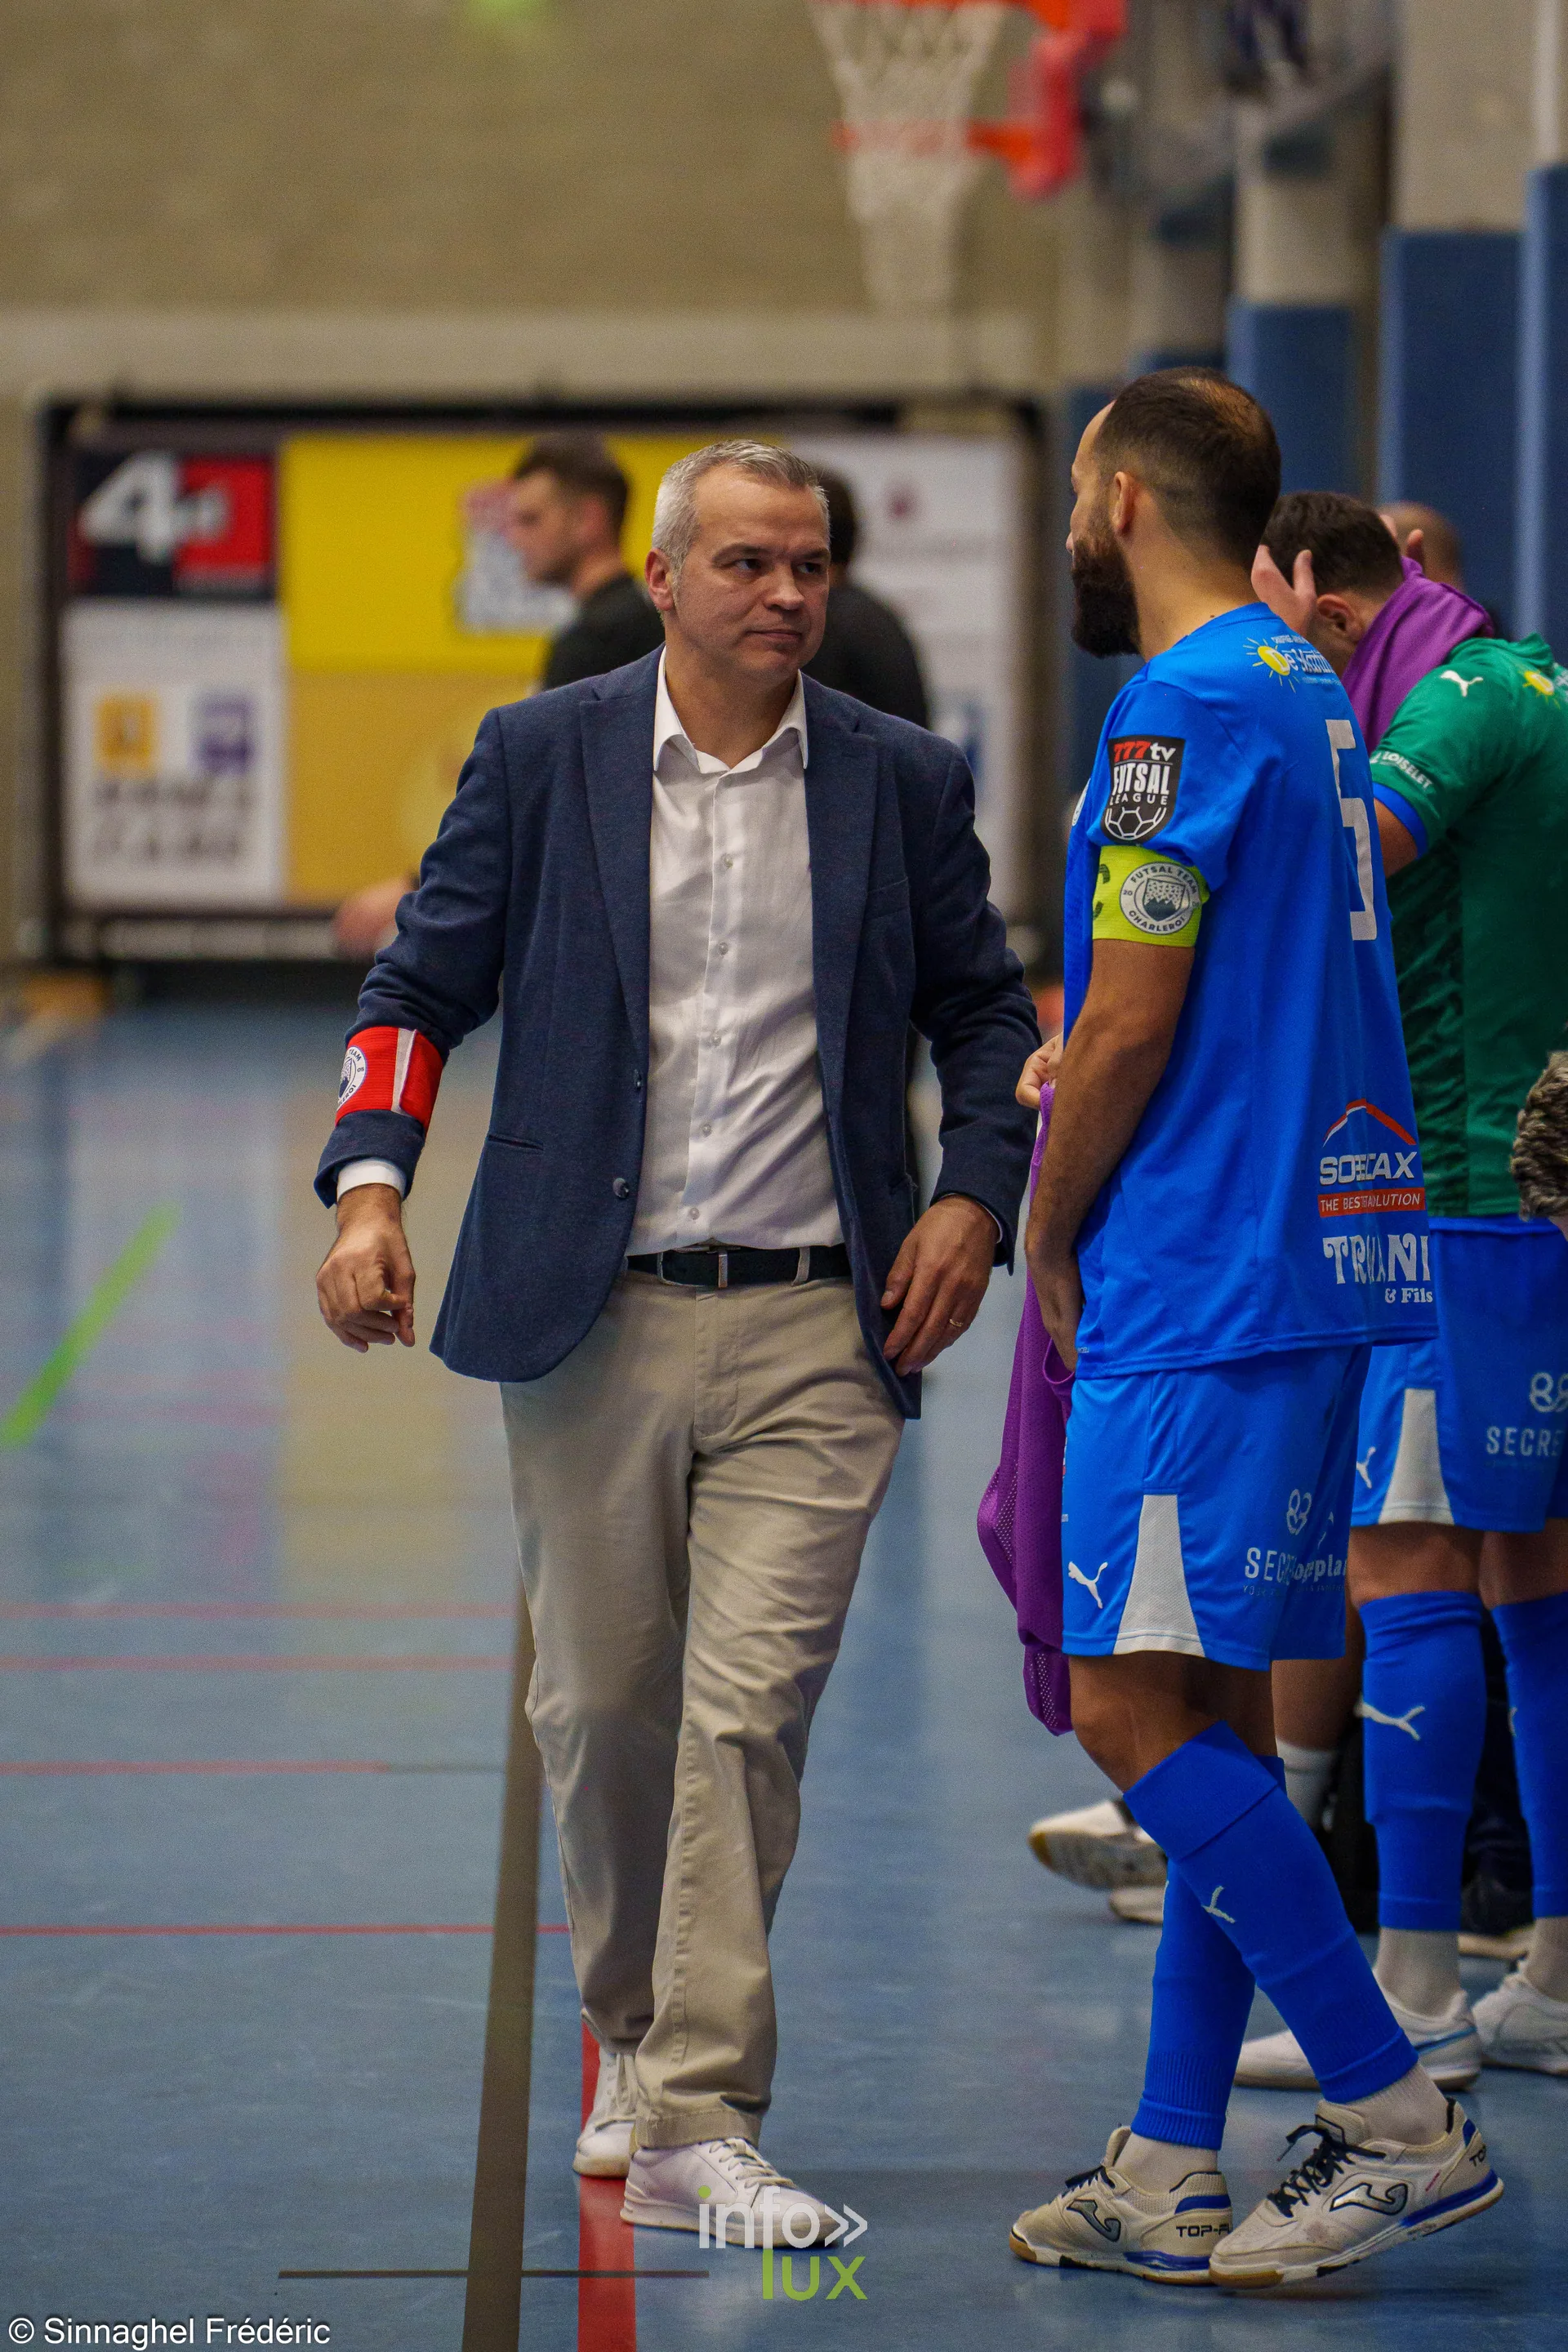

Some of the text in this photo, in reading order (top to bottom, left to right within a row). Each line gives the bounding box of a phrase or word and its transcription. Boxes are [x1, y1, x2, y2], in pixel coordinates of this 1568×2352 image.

[1112, 763, 1170, 795] FUTSAL
[1382, 751, 1432, 790] LOISELET
[1110, 793, 1168, 805] LEAGUE
[1325, 719, 1378, 941] 5
[1130, 866, 1198, 894] FUTSAL TEAM
[1129, 910, 1186, 932] CHARLEROI
[349, 1049, 362, 1062] TEAM
[1321, 1197, 1339, 1212] THE
[1385, 1287, 1433, 1303] & Fils
